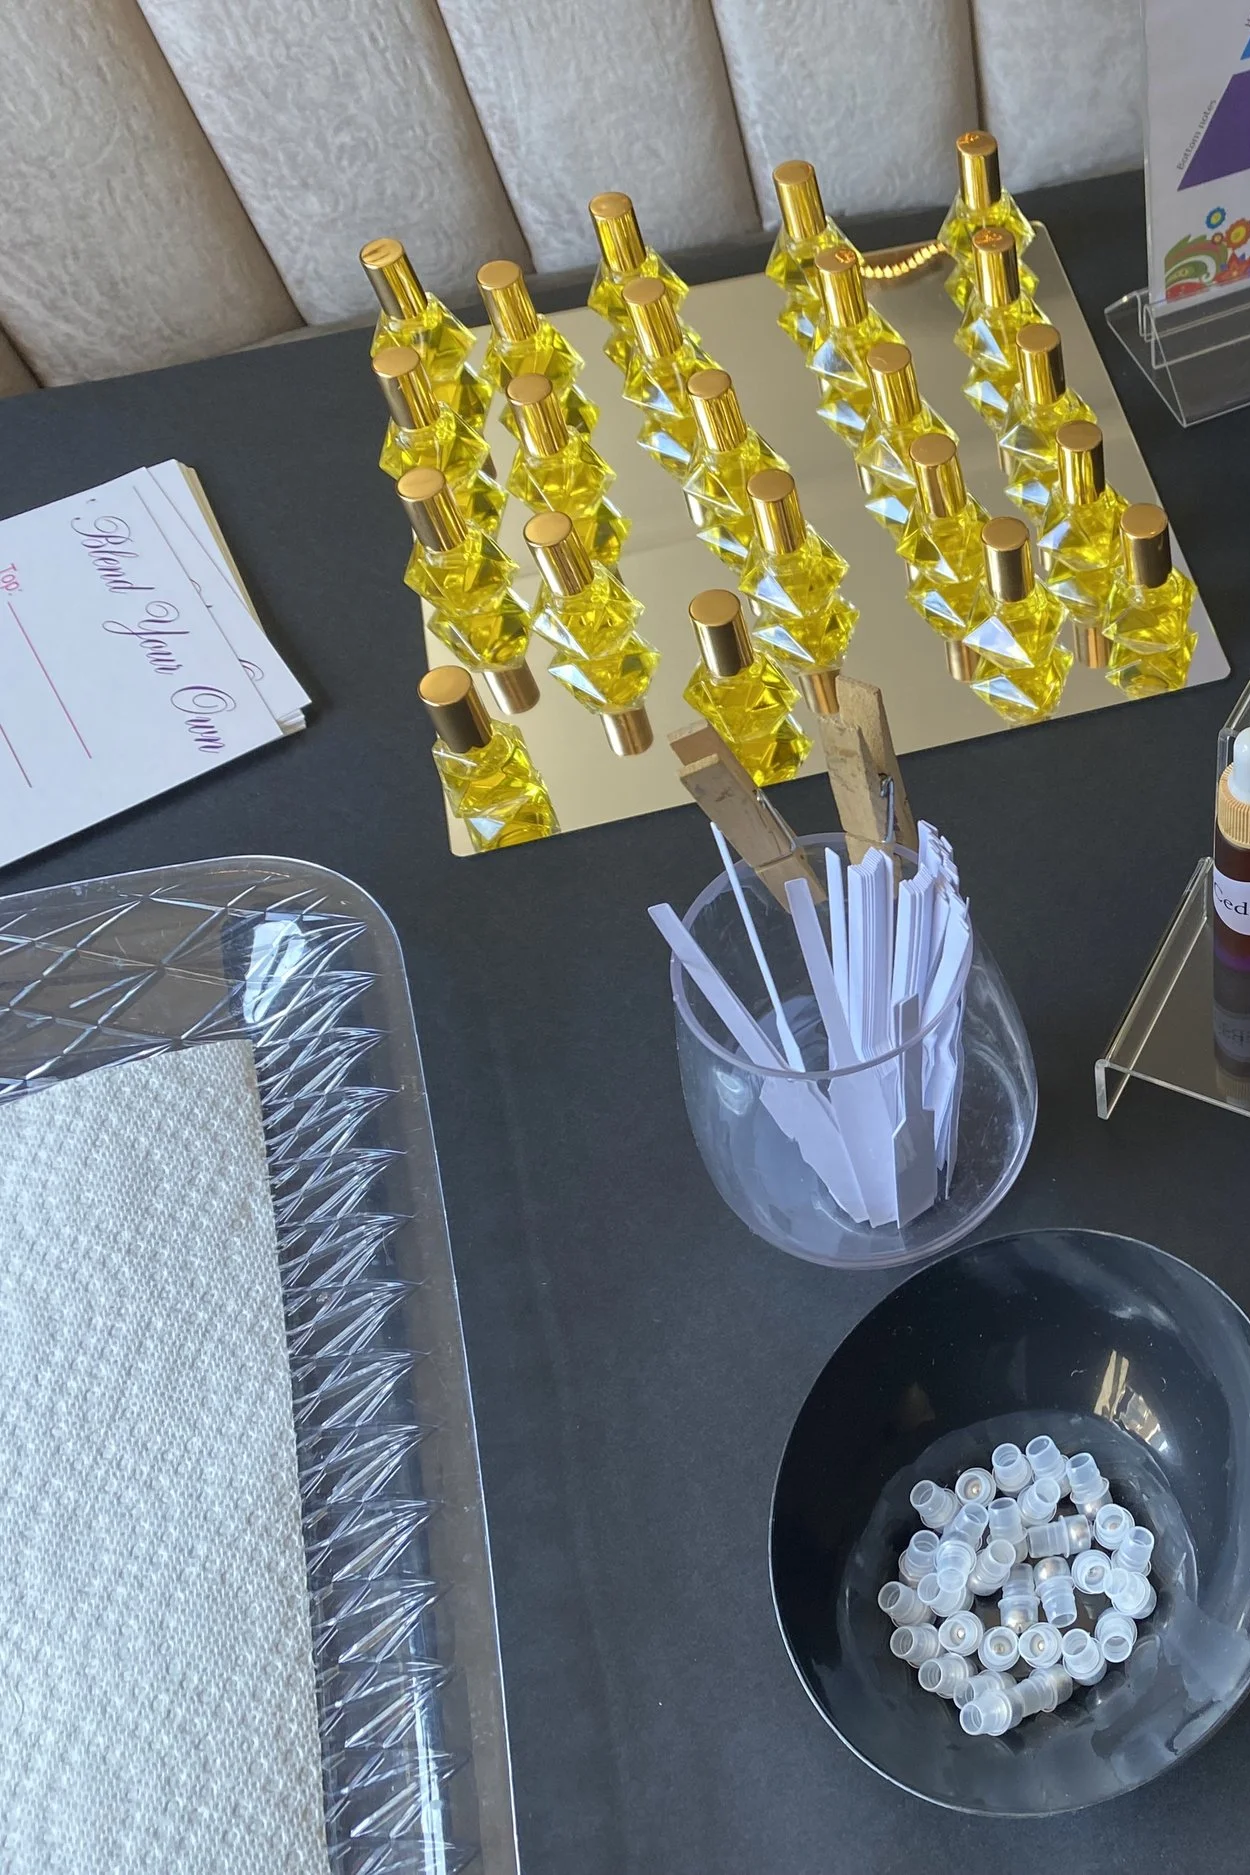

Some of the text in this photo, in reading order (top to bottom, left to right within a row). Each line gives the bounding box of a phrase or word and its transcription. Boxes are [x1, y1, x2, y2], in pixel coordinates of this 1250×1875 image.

[1176, 99, 1217, 171] Bottom notes
[0, 563, 22, 596] Top:
[71, 515, 237, 753] Blend Your Own
